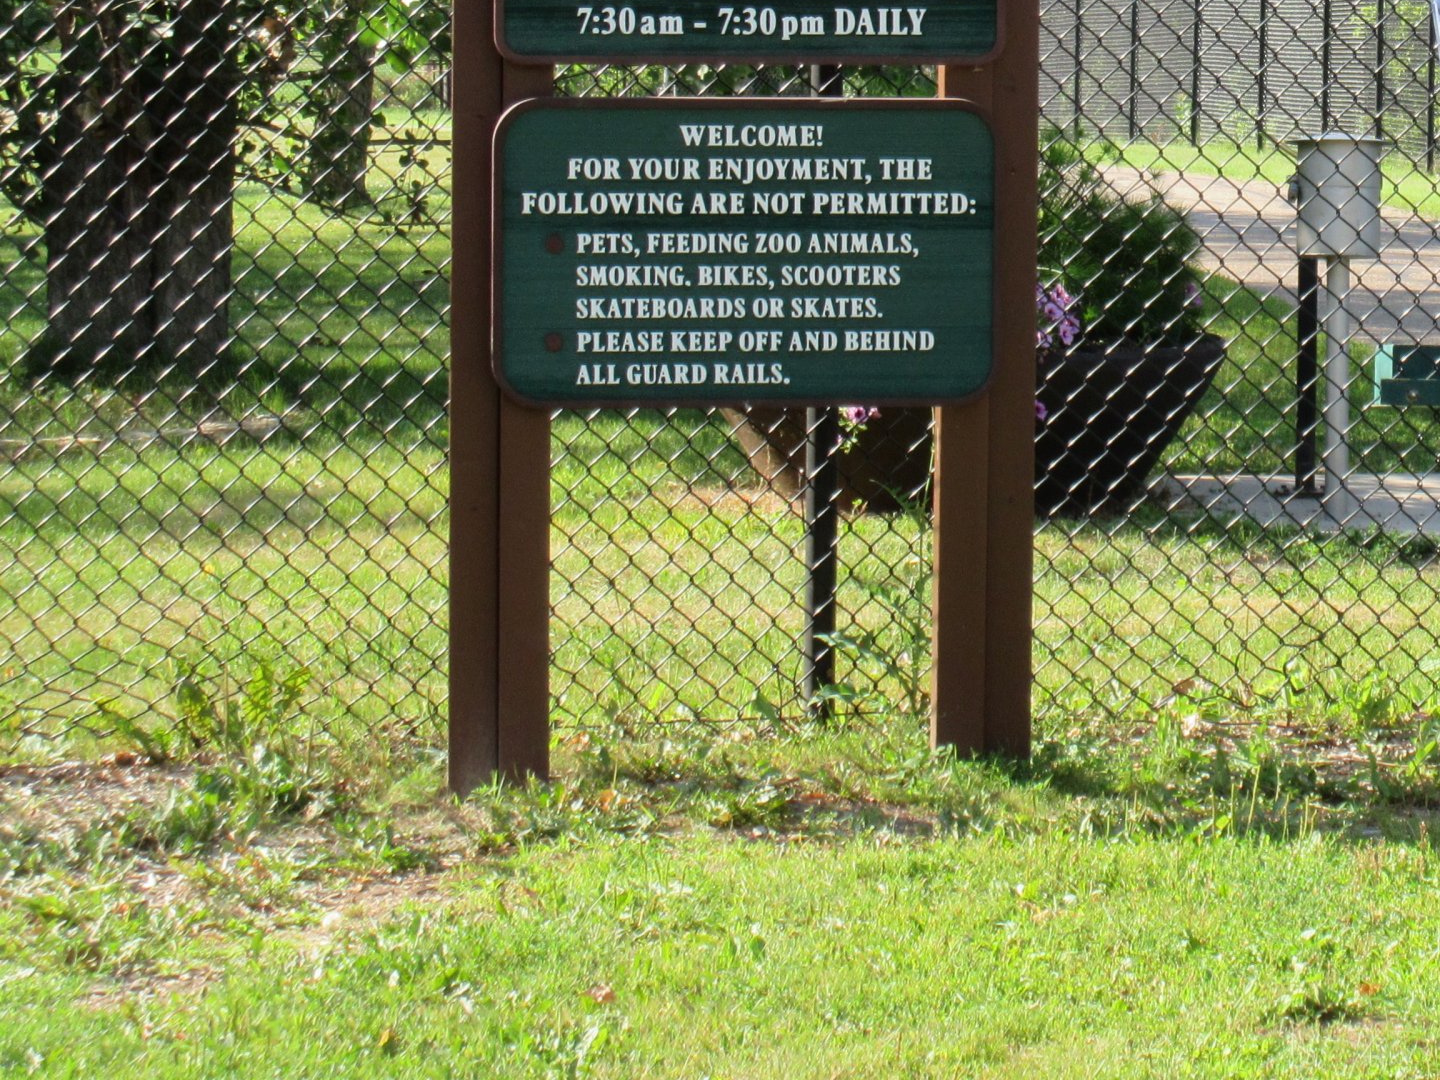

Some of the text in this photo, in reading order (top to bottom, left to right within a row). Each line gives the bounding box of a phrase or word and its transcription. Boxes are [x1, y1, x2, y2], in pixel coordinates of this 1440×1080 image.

[834, 8, 927, 36] DAILY
[679, 124, 823, 147] WELCOME!
[567, 157, 933, 185] FOR YOUR ENJOYMENT, THE
[521, 192, 976, 215] FOLLOWING ARE NOT PERMITTED:
[576, 232, 919, 258] PETS, FEEDING ZOO ANIMALS,
[576, 265, 901, 290] SMOKING. BIKES, SCOOTERS
[576, 297, 883, 319] SKATEBOARDS OR SKATES.
[576, 330, 935, 353] PLEASE KEEP OFF AND BEHIND
[576, 363, 791, 385] ALL GUARD RAILS.
